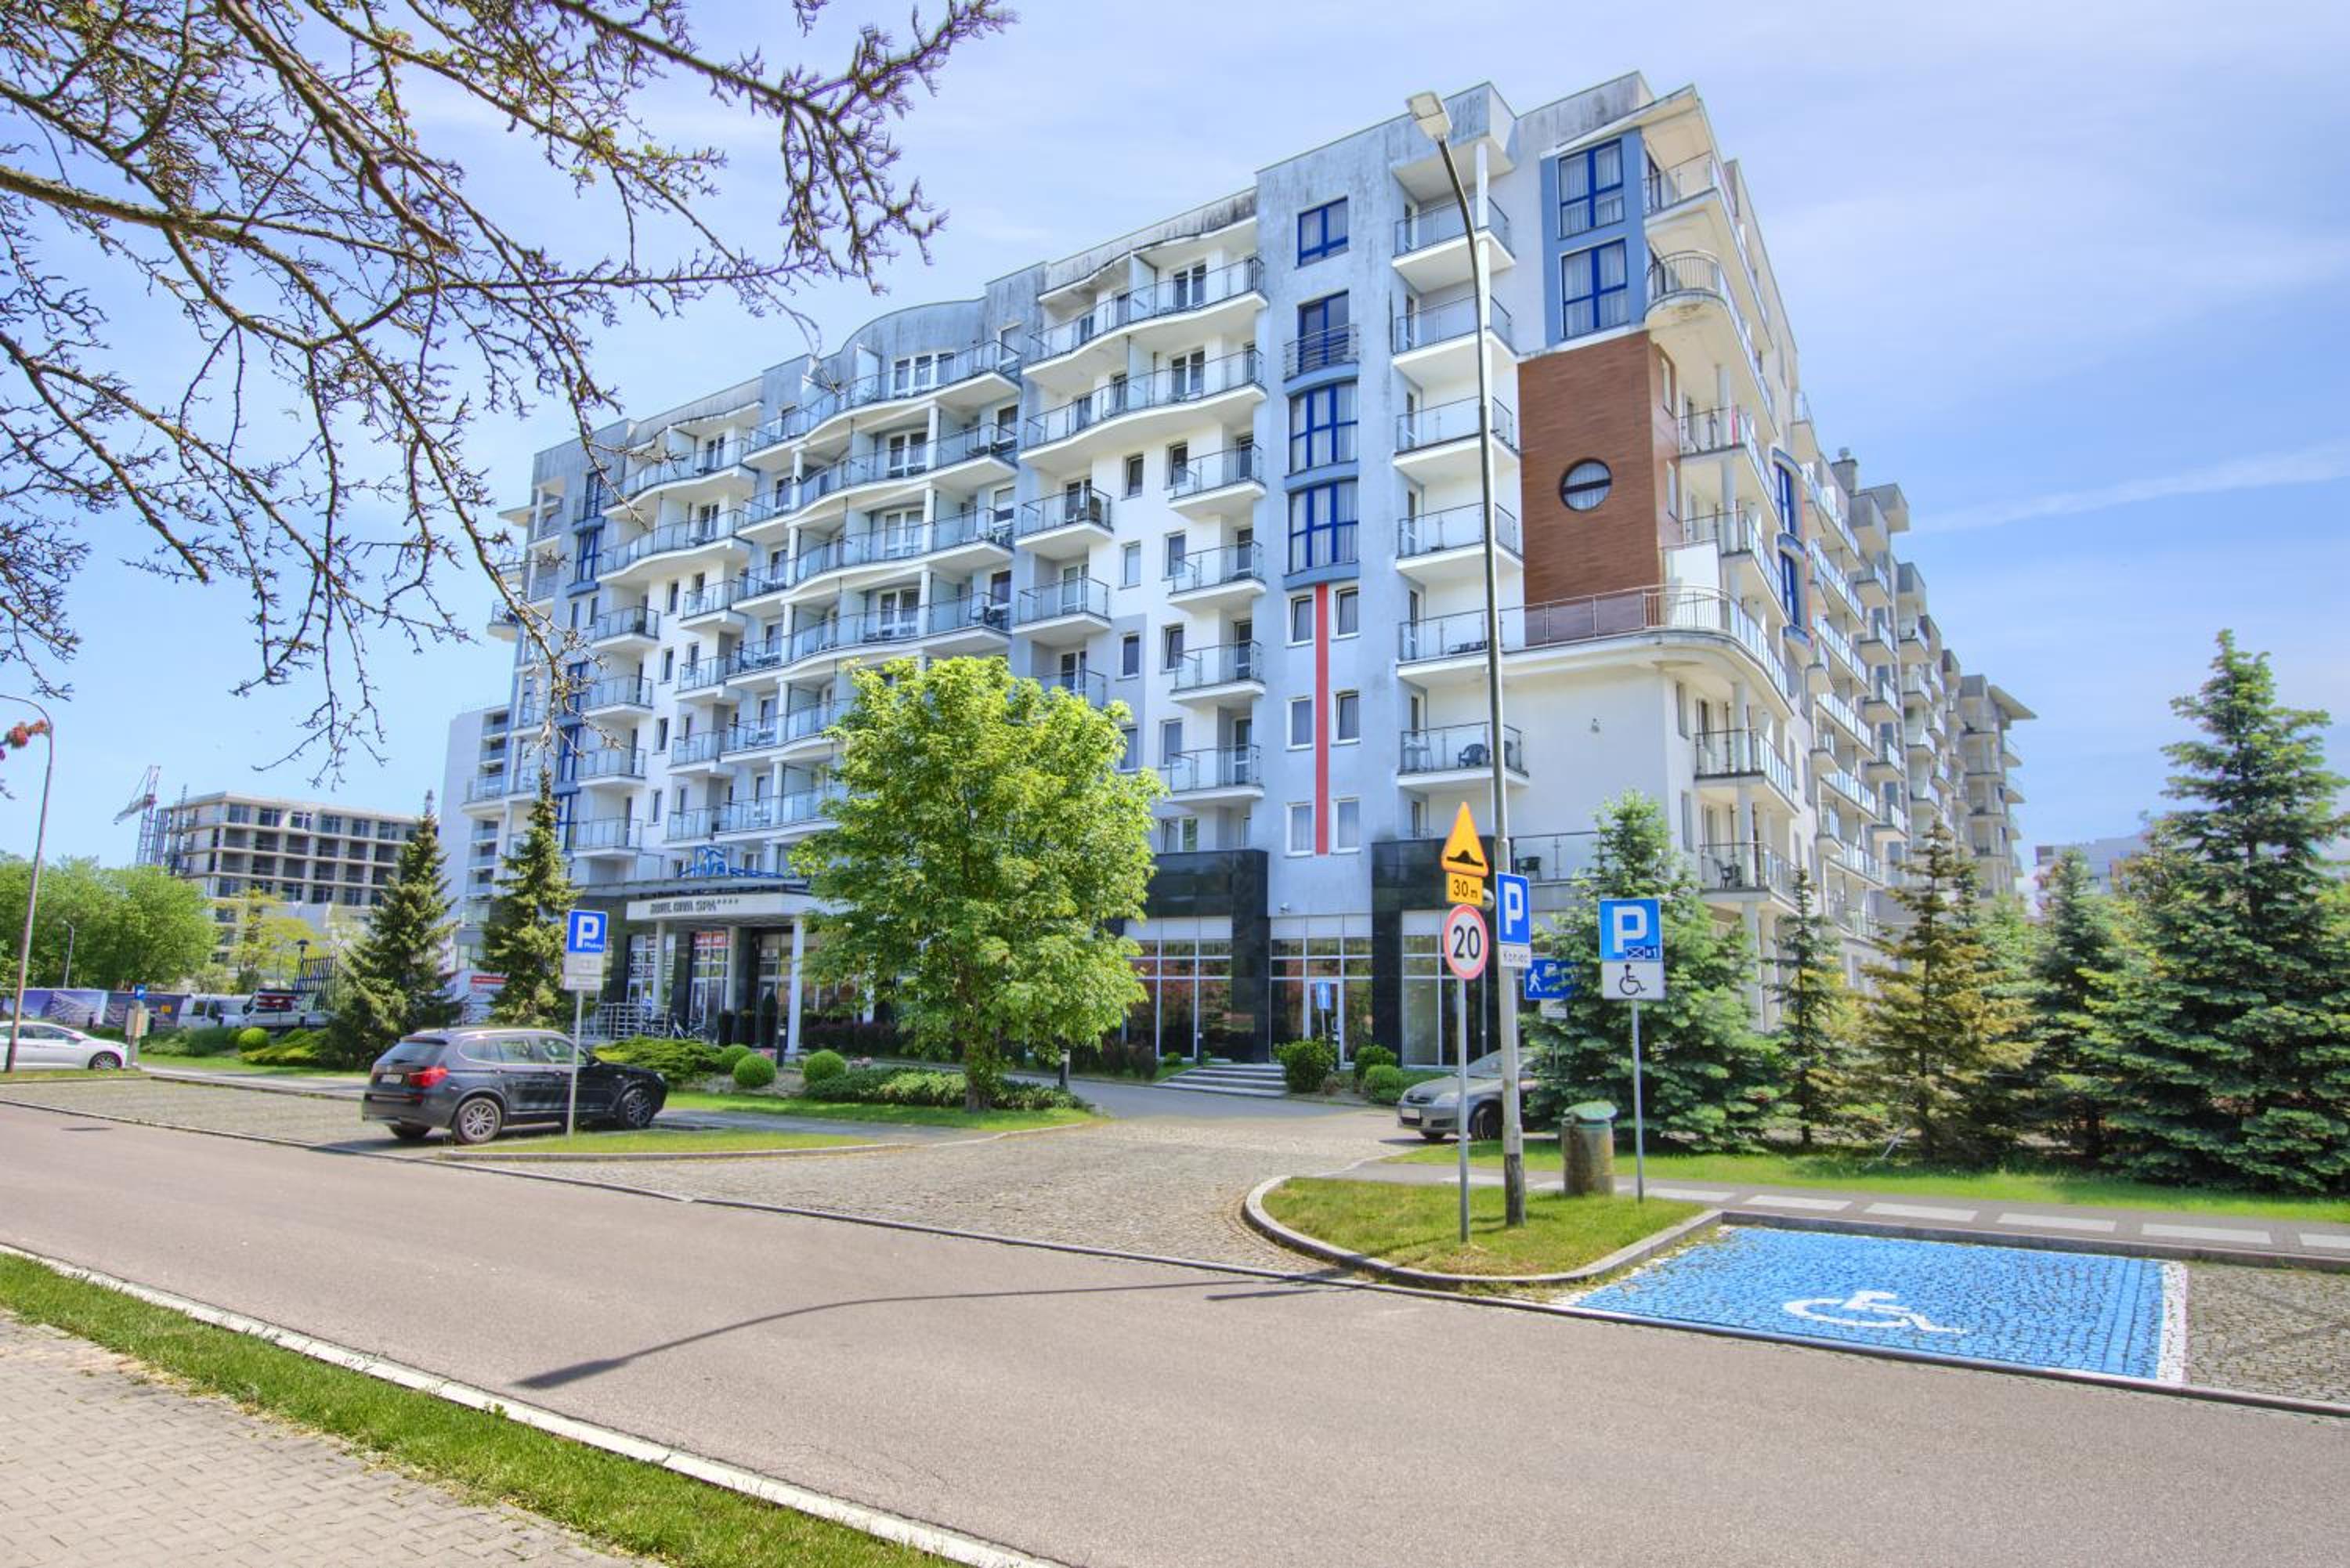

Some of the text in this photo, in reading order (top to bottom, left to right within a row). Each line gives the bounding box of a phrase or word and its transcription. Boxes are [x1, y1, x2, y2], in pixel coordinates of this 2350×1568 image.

[1453, 879, 1469, 898] 30
[1504, 881, 1524, 935] P
[576, 915, 599, 948] P
[1453, 925, 1481, 959] 20
[1614, 905, 1647, 952] P
